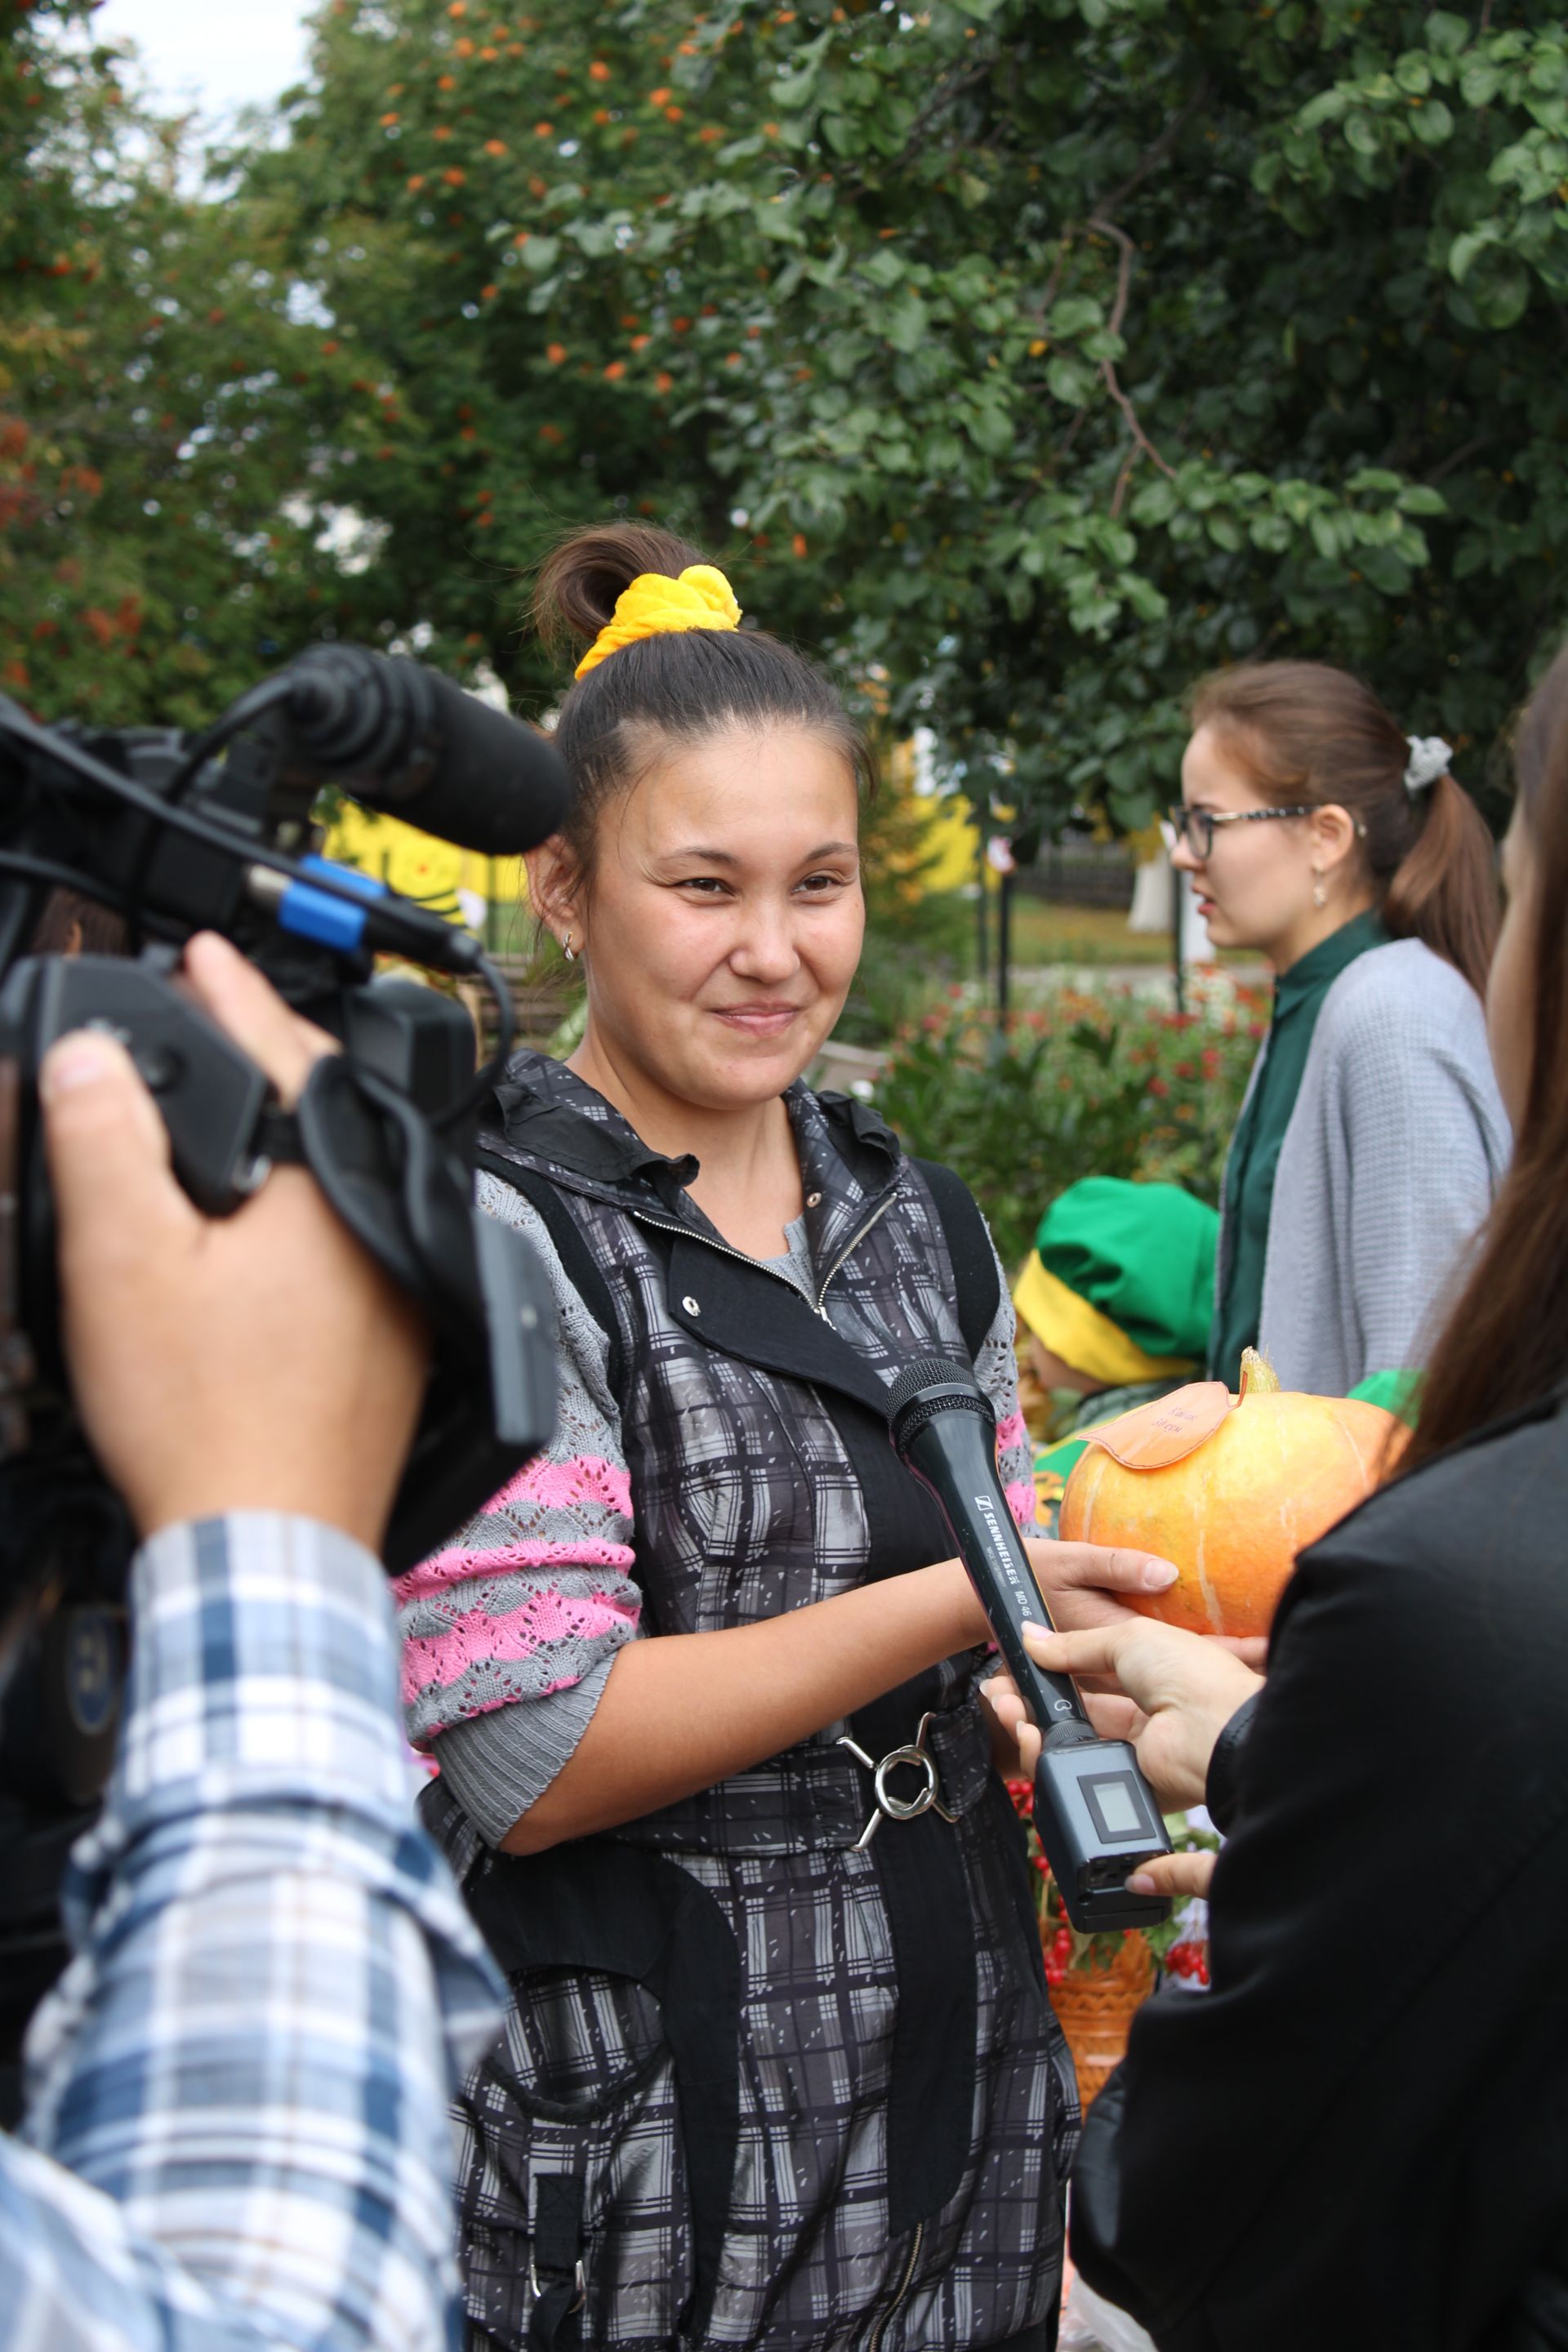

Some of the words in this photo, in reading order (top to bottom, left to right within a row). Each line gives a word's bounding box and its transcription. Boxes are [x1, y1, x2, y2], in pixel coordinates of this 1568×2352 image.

[983, 1512, 1020, 1585] SENNHEISER
[1014, 1590, 1027, 1605] MD
[1021, 1606, 1032, 1617] 46
